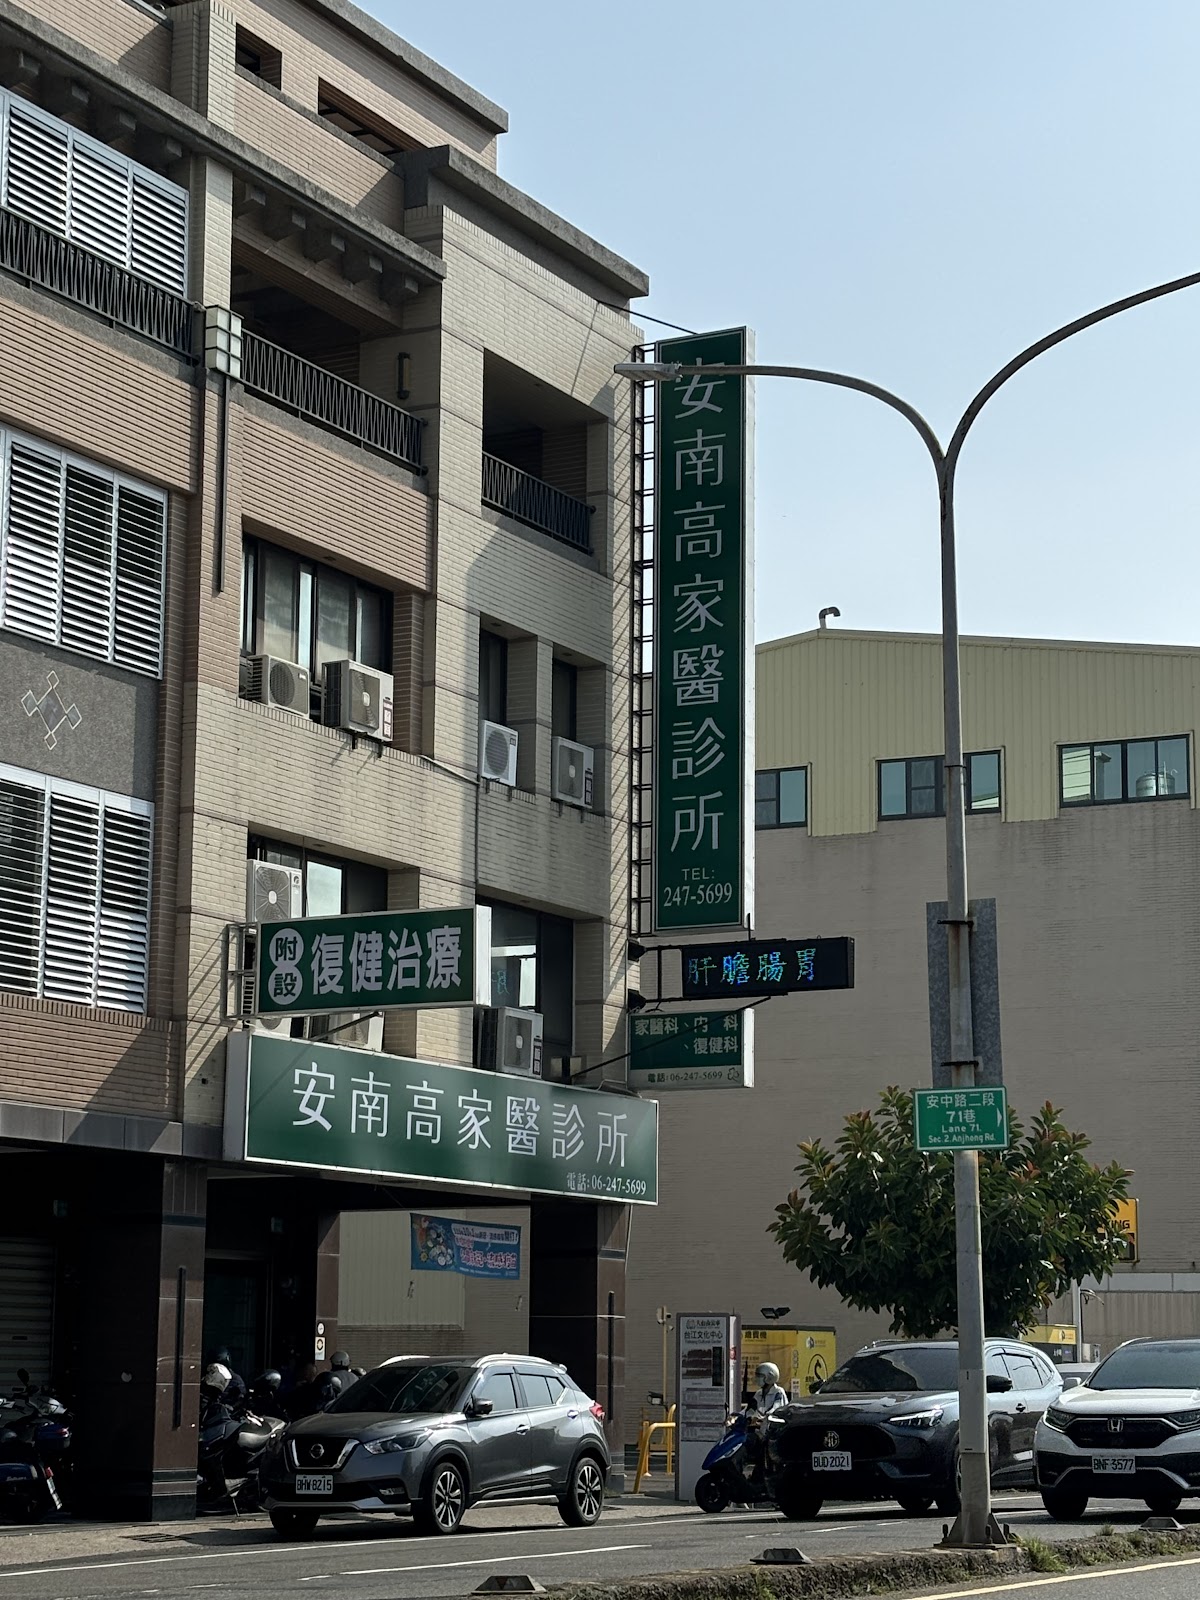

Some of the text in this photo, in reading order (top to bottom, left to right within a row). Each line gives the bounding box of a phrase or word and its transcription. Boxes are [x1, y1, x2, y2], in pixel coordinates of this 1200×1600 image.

[671, 357, 727, 852] 安南高家醫診所
[681, 868, 715, 881] TEL:
[663, 882, 733, 907] 247-5699
[273, 936, 298, 998] 附設
[310, 925, 462, 995] 復健治療
[926, 1092, 995, 1109] 安中路二段
[292, 1061, 629, 1169] 安南高家醫診所
[945, 1109, 976, 1123] 71巷
[941, 1124, 967, 1133] Lane
[684, 1330, 723, 1340] 台江文化中心
